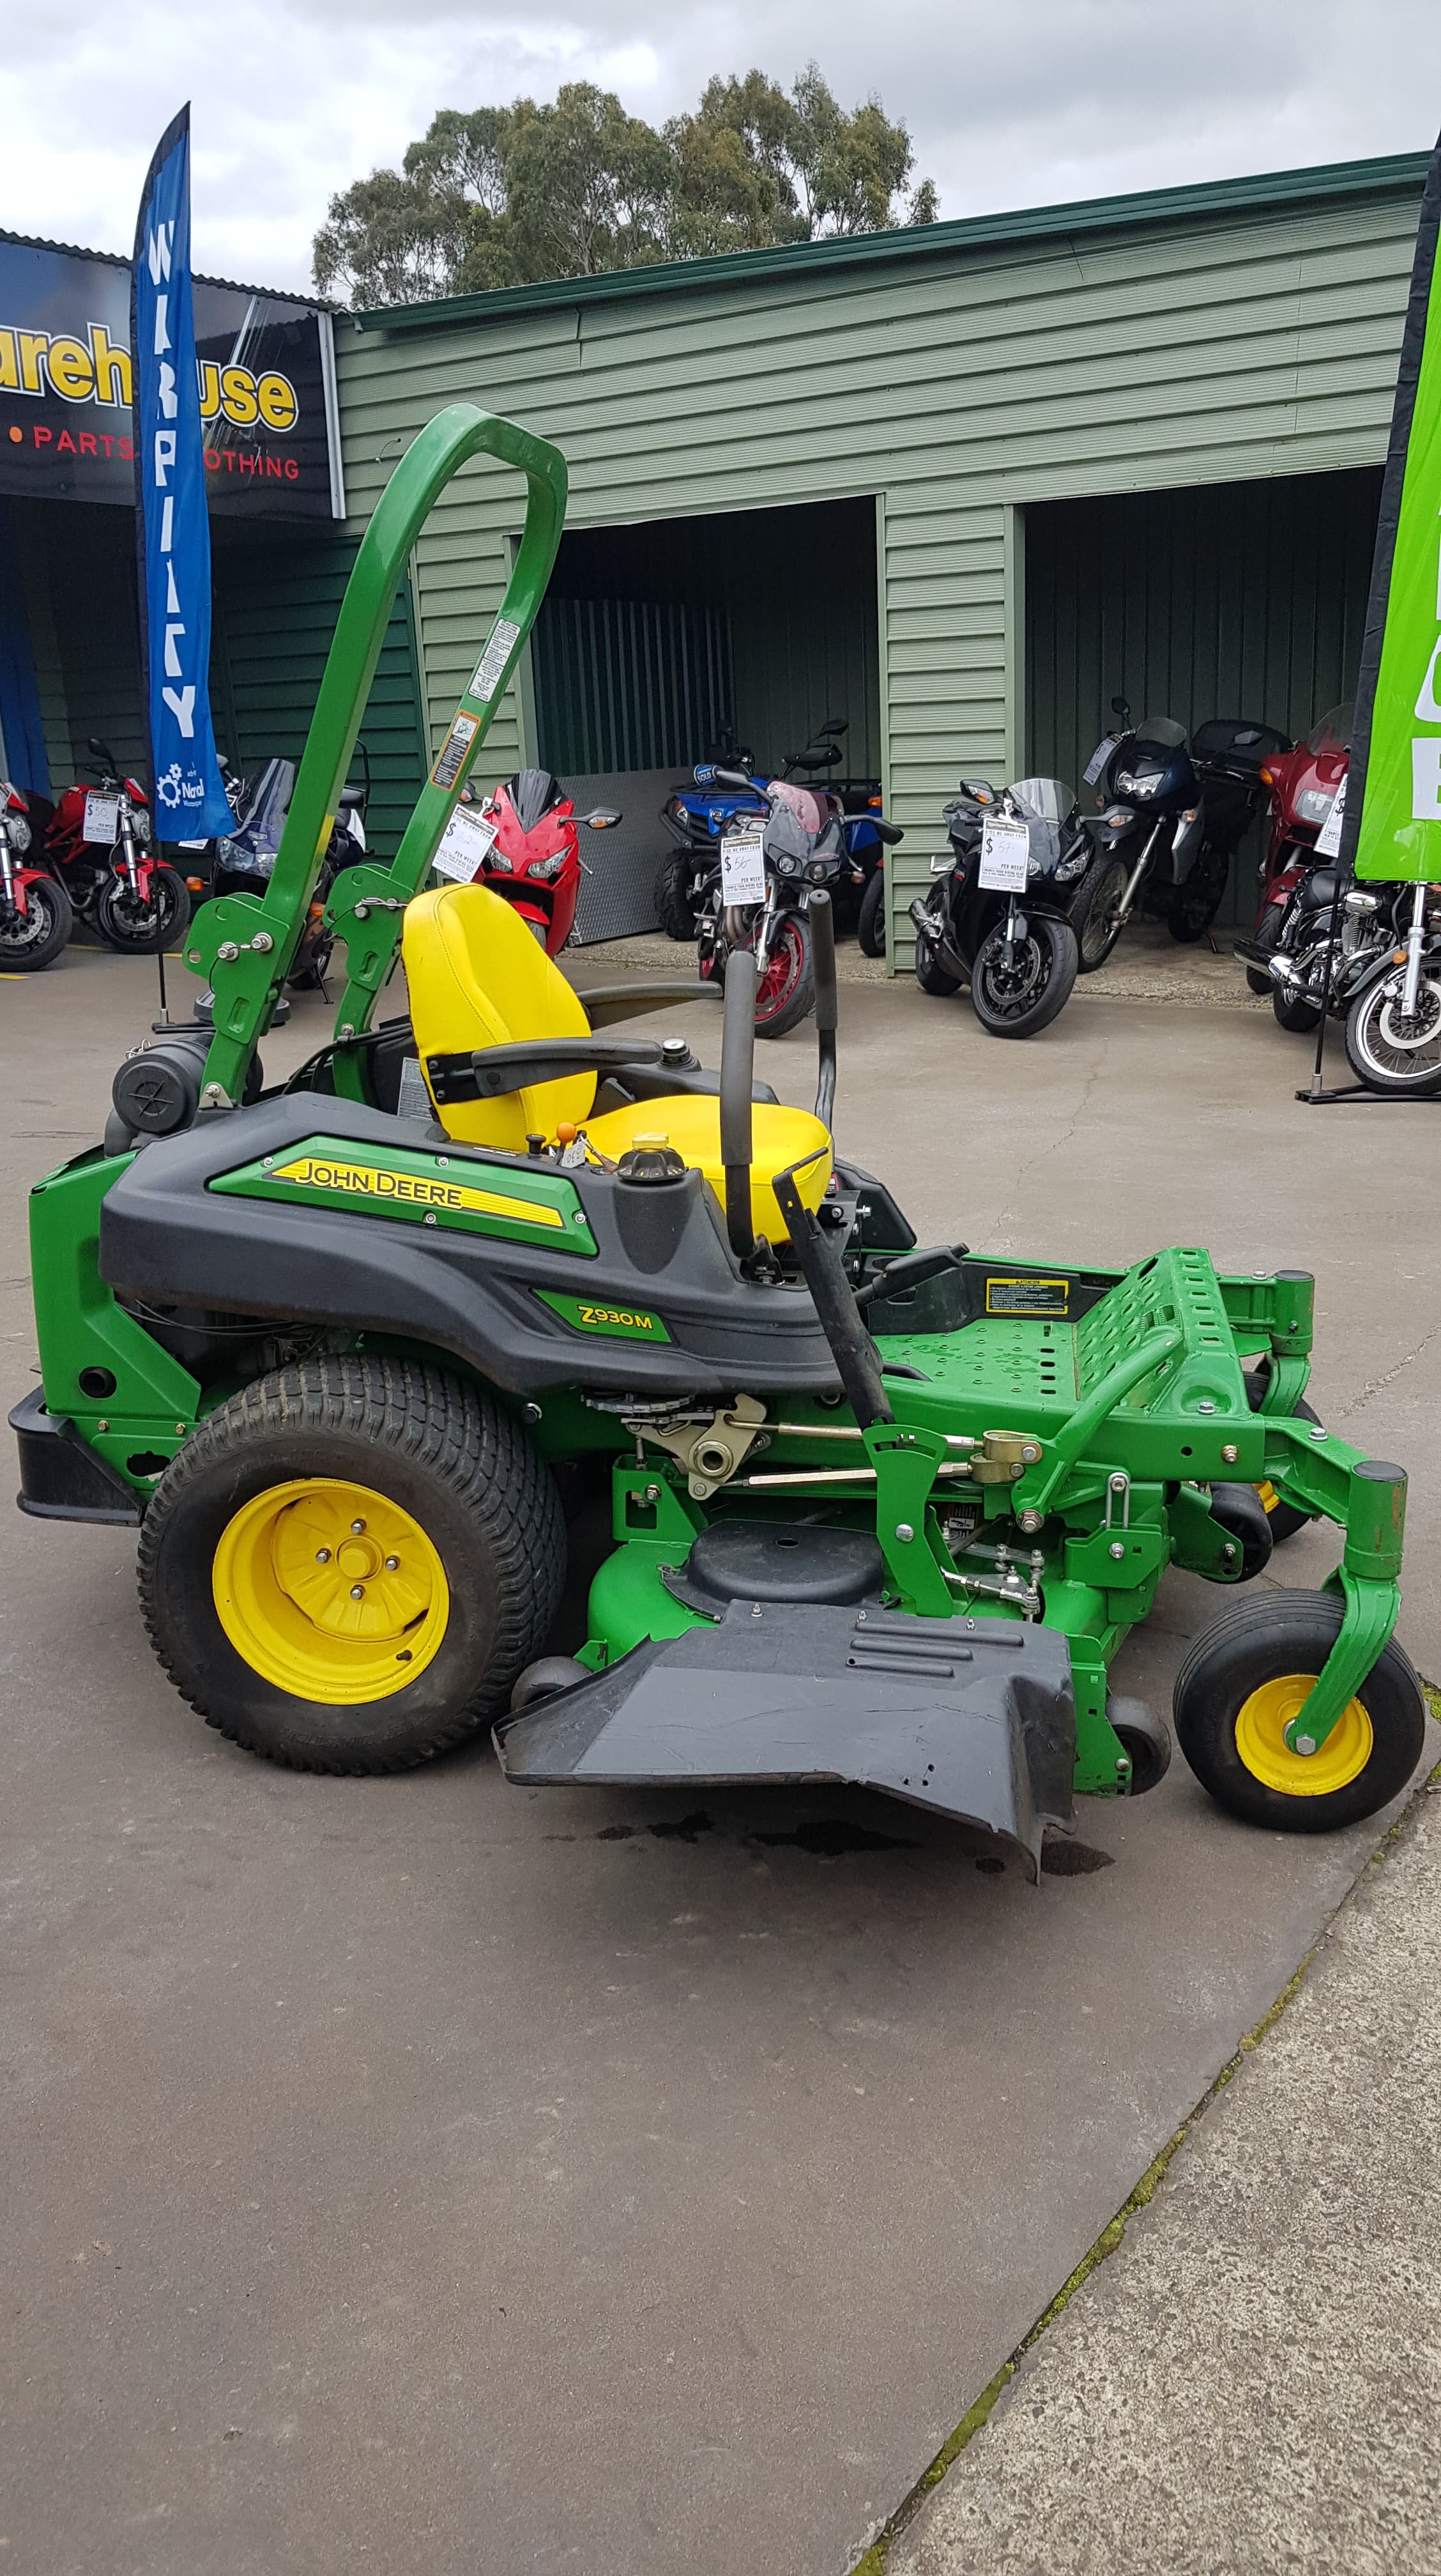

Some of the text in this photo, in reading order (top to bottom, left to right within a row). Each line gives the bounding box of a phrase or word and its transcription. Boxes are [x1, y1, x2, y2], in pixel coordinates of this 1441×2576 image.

[34, 426, 299, 480] PARTS OTHING
[697, 772, 712, 782] SOLD
[446, 822, 457, 838] $
[986, 837, 993, 855] $
[724, 855, 731, 873] $
[298, 1163, 462, 1206] JOHN DEERE
[577, 1305, 653, 1330] Z930M
